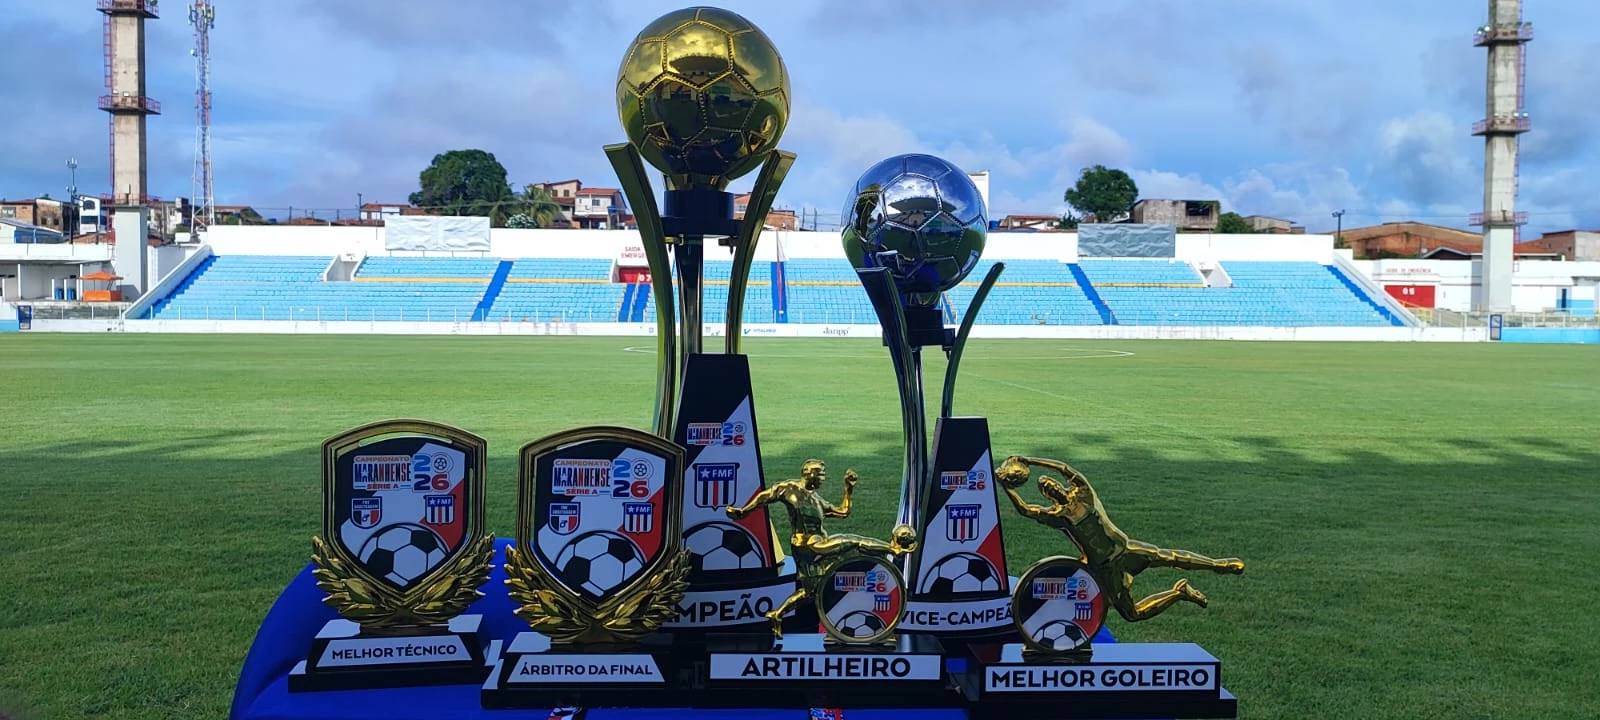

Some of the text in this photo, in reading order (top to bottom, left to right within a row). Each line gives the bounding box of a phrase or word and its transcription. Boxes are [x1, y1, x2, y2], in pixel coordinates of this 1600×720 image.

[723, 434, 745, 446] 26
[413, 473, 450, 491] 26
[553, 467, 611, 487] MARANHENSE
[712, 469, 733, 478] FMF
[612, 480, 649, 498] 26
[960, 509, 977, 517] FMF
[866, 582, 886, 593] 26
[666, 593, 773, 623] MPEÃO
[901, 602, 1012, 626] VICE-CAMPEÃ
[332, 643, 457, 660] MELHOR TÉCNICO
[520, 661, 653, 676] ÁRBITRO DA FINAL
[741, 657, 911, 678] ARTILHEIRO
[992, 669, 1209, 688] MELHOR GOLEIRO
